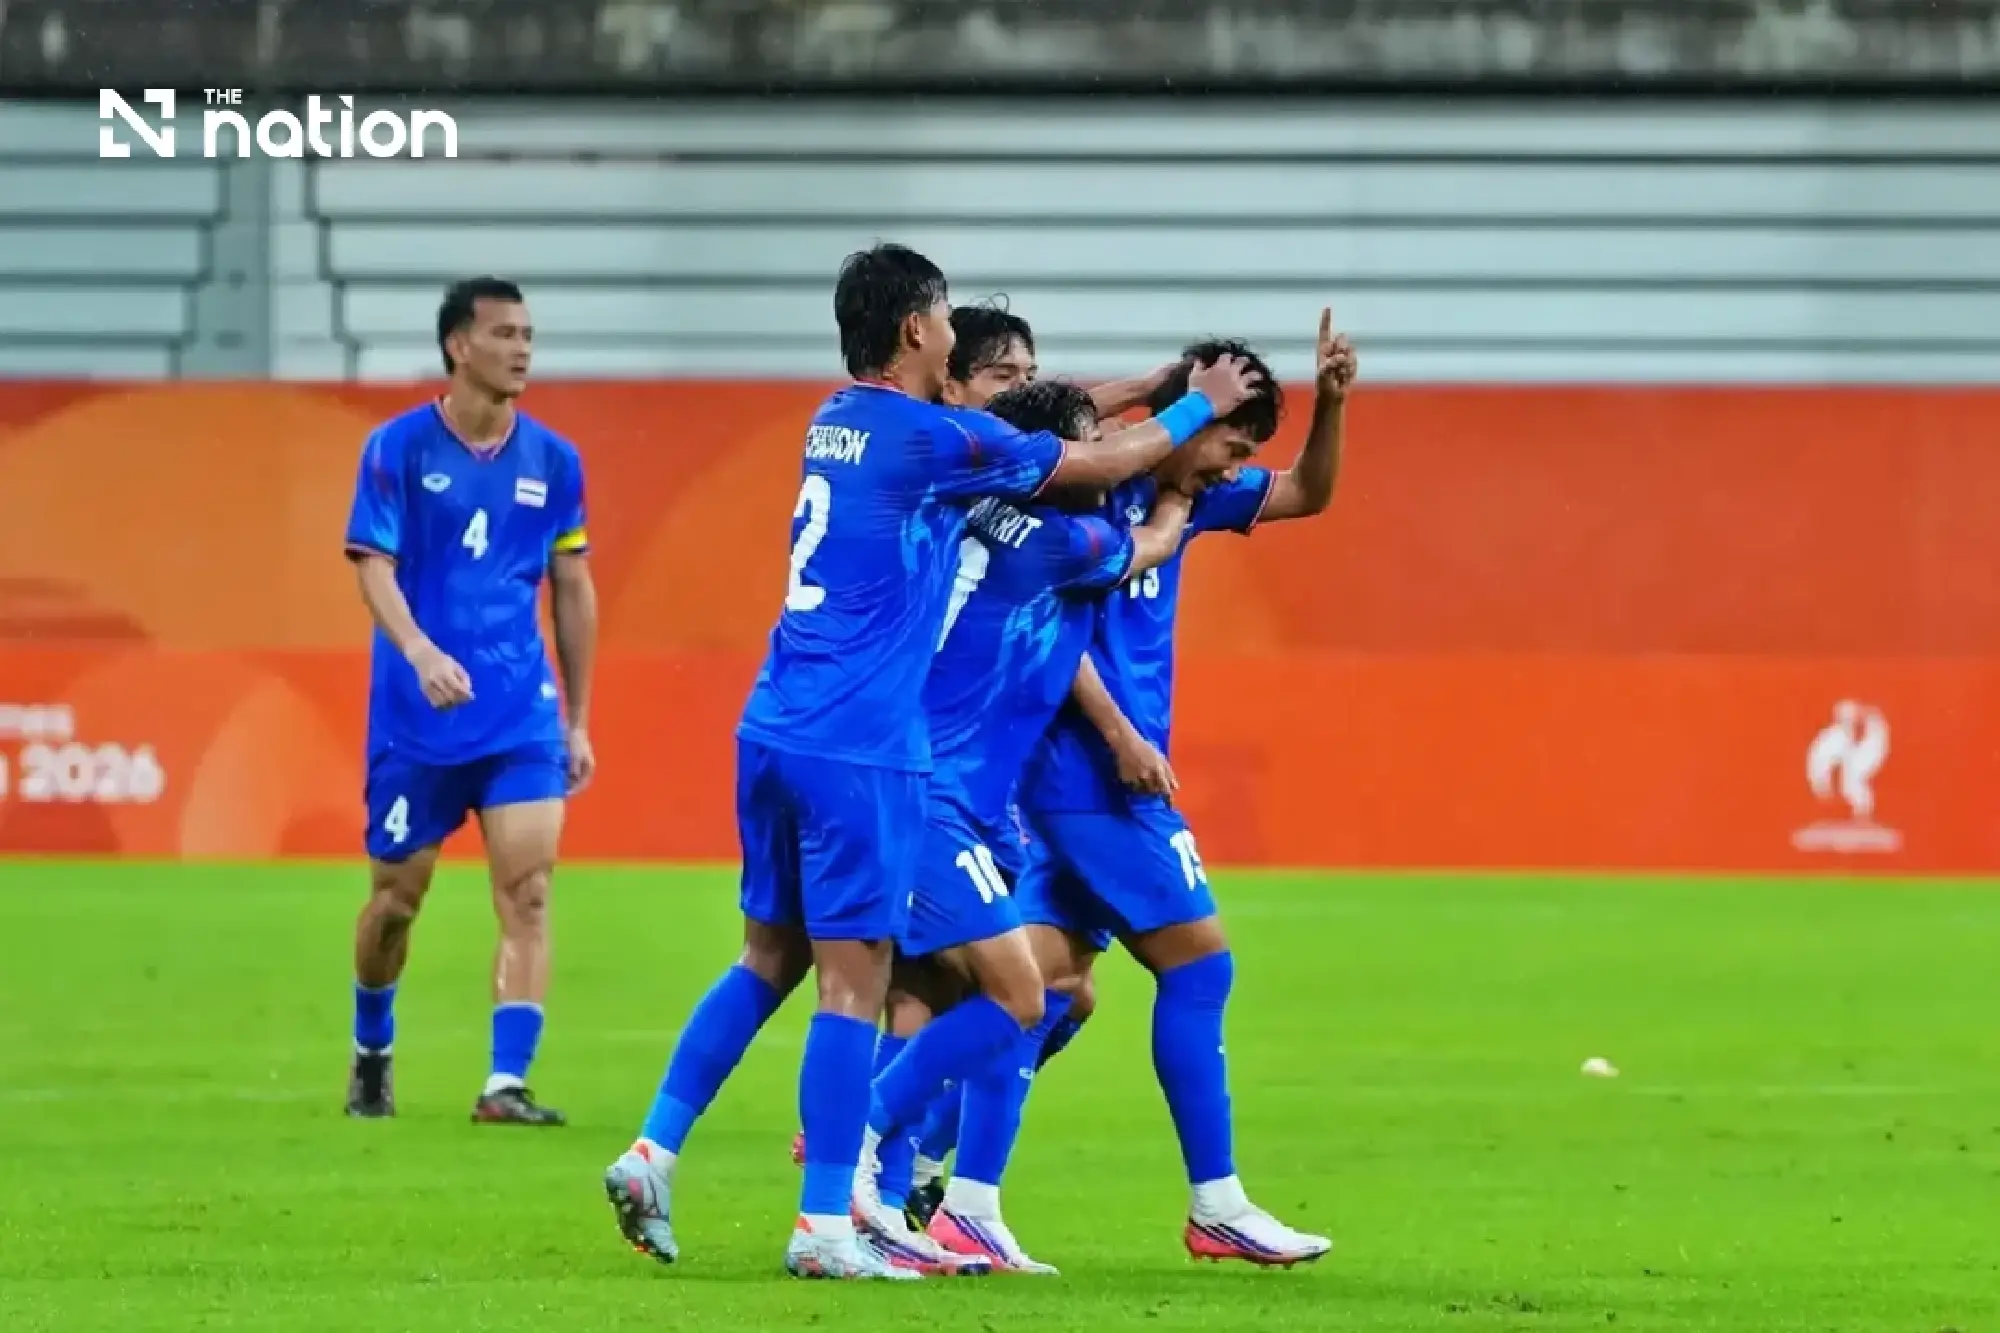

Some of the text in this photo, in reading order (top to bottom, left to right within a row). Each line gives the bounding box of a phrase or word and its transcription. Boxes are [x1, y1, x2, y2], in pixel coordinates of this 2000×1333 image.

[462, 507, 489, 560] 4
[785, 475, 831, 611] 2
[19, 742, 167, 803] 2026
[385, 795, 411, 843] 4
[955, 844, 1009, 904] 10
